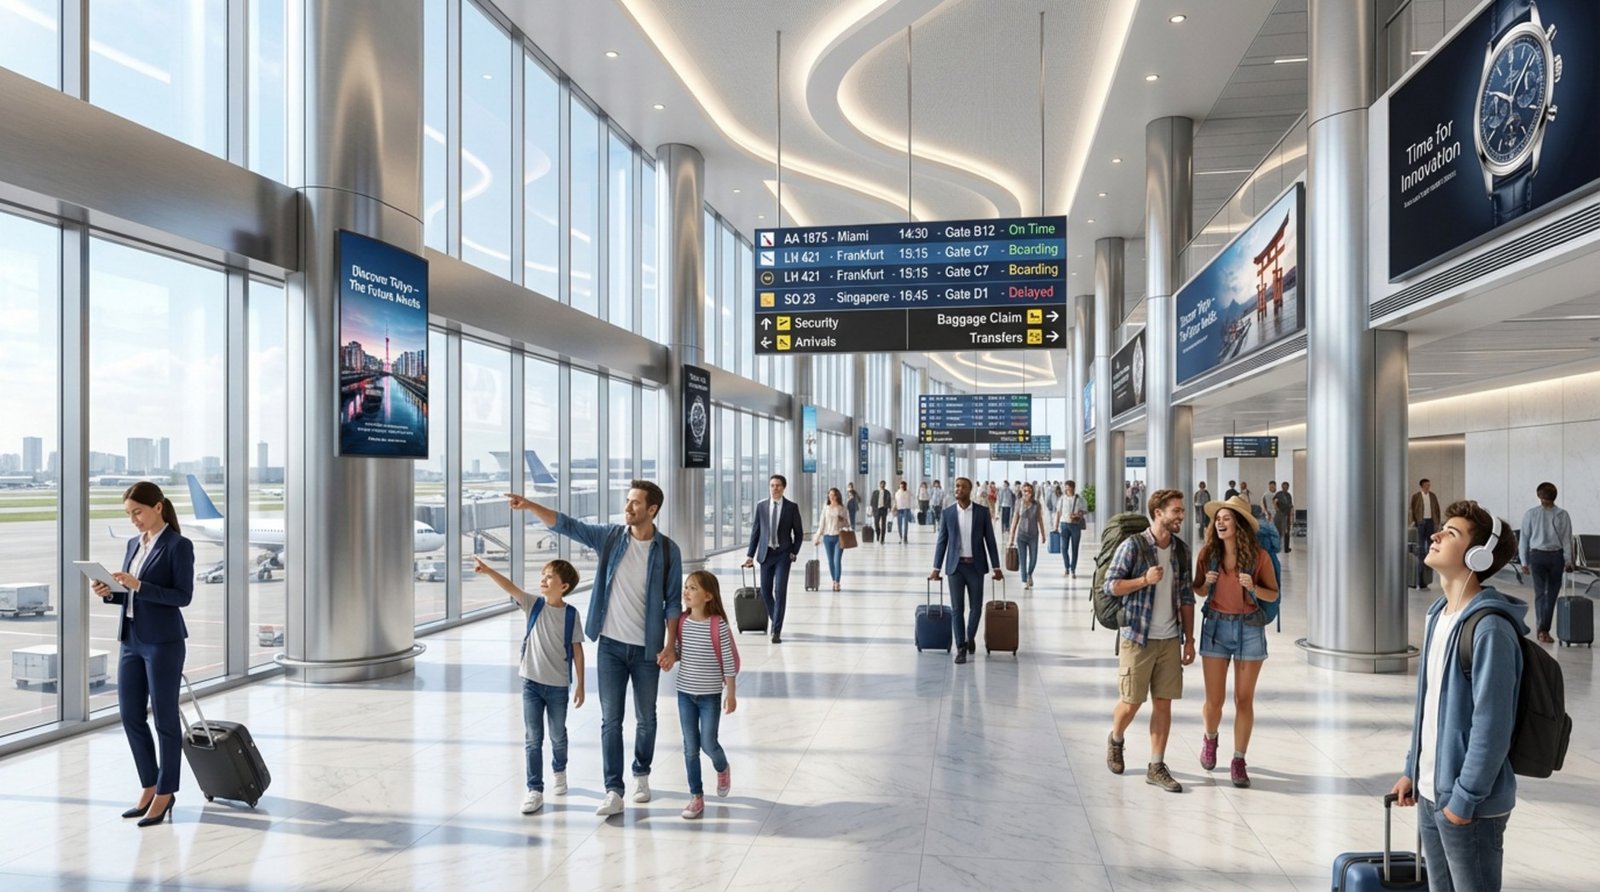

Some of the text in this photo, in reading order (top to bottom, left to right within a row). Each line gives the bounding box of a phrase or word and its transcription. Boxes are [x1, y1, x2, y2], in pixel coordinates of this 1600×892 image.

[1406, 120, 1453, 165] Time for
[1401, 141, 1461, 193] Innovation
[784, 233, 800, 244] AA
[803, 232, 828, 243] 1875
[837, 230, 869, 242] Miami
[945, 227, 971, 238] Gate
[974, 225, 995, 236] B12
[1009, 224, 1025, 235] On
[1028, 223, 1055, 234] Time
[784, 252, 798, 263] LH
[837, 249, 884, 261] Frankfurt
[945, 247, 971, 258] Gate
[974, 245, 989, 256] C7
[784, 271, 798, 283] LH
[801, 271, 820, 282] 421
[837, 269, 884, 280] Frankfurt
[945, 266, 971, 277] Gate
[974, 265, 989, 276] C7
[349, 279, 366, 294] The
[802, 293, 816, 304] 23
[945, 289, 971, 300] Gate
[974, 288, 988, 299] D1
[1008, 285, 1054, 300] Delayed
[794, 317, 839, 330] Security
[937, 312, 1022, 327] Baggage Claim
[969, 331, 1023, 344] Transfers
